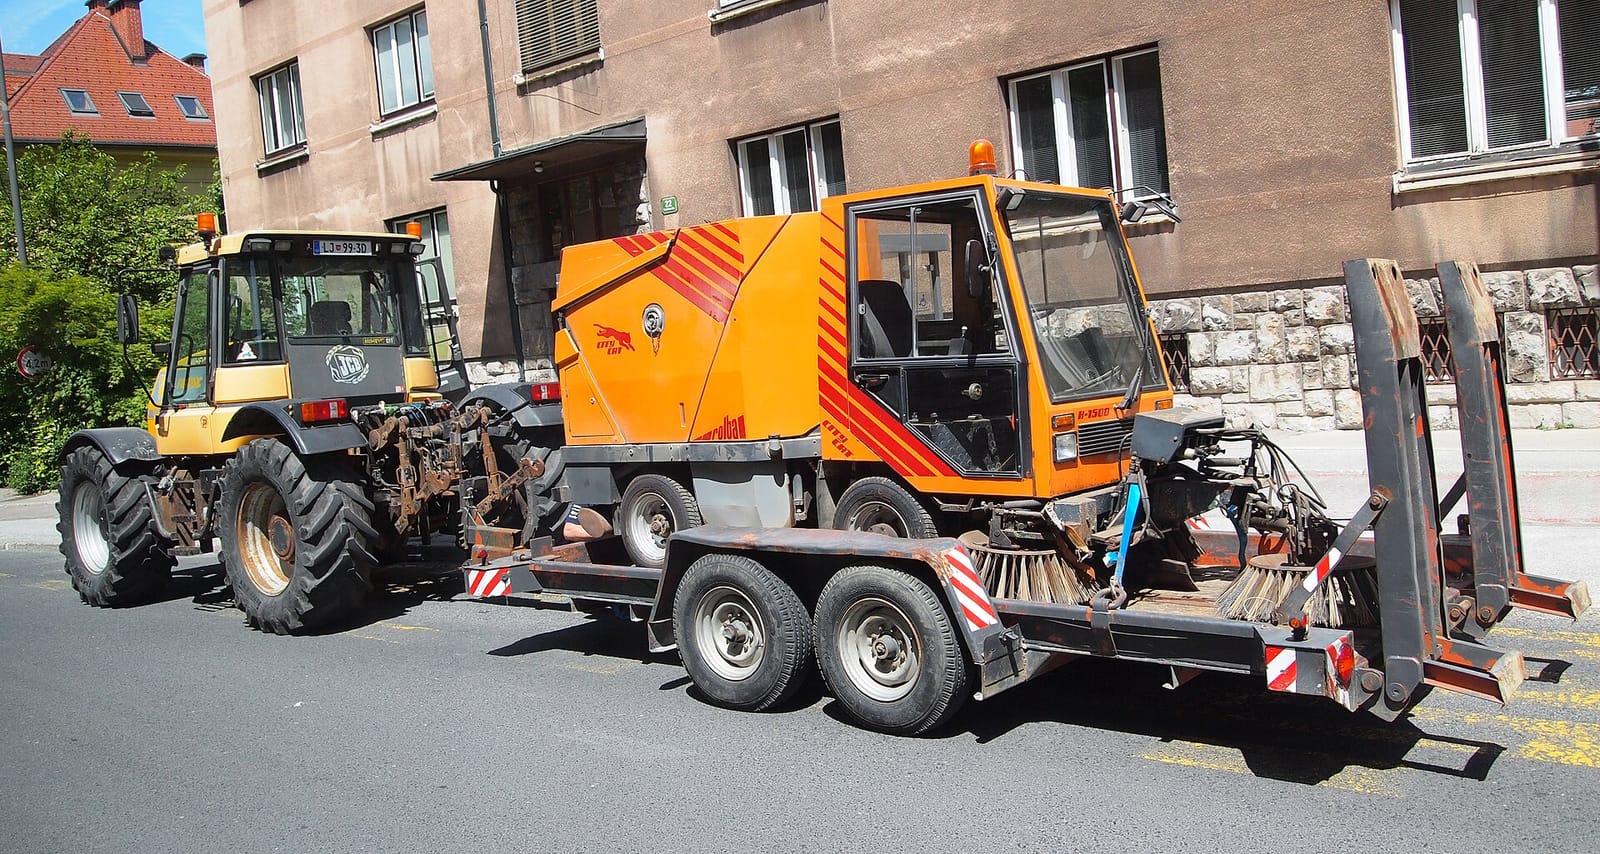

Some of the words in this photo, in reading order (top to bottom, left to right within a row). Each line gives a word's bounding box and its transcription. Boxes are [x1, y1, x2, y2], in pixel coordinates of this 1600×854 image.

[664, 199, 673, 208] 22
[597, 340, 615, 348] CITY
[337, 355, 362, 377] JCB
[711, 415, 739, 441] rolba
[822, 419, 849, 444] CITY
